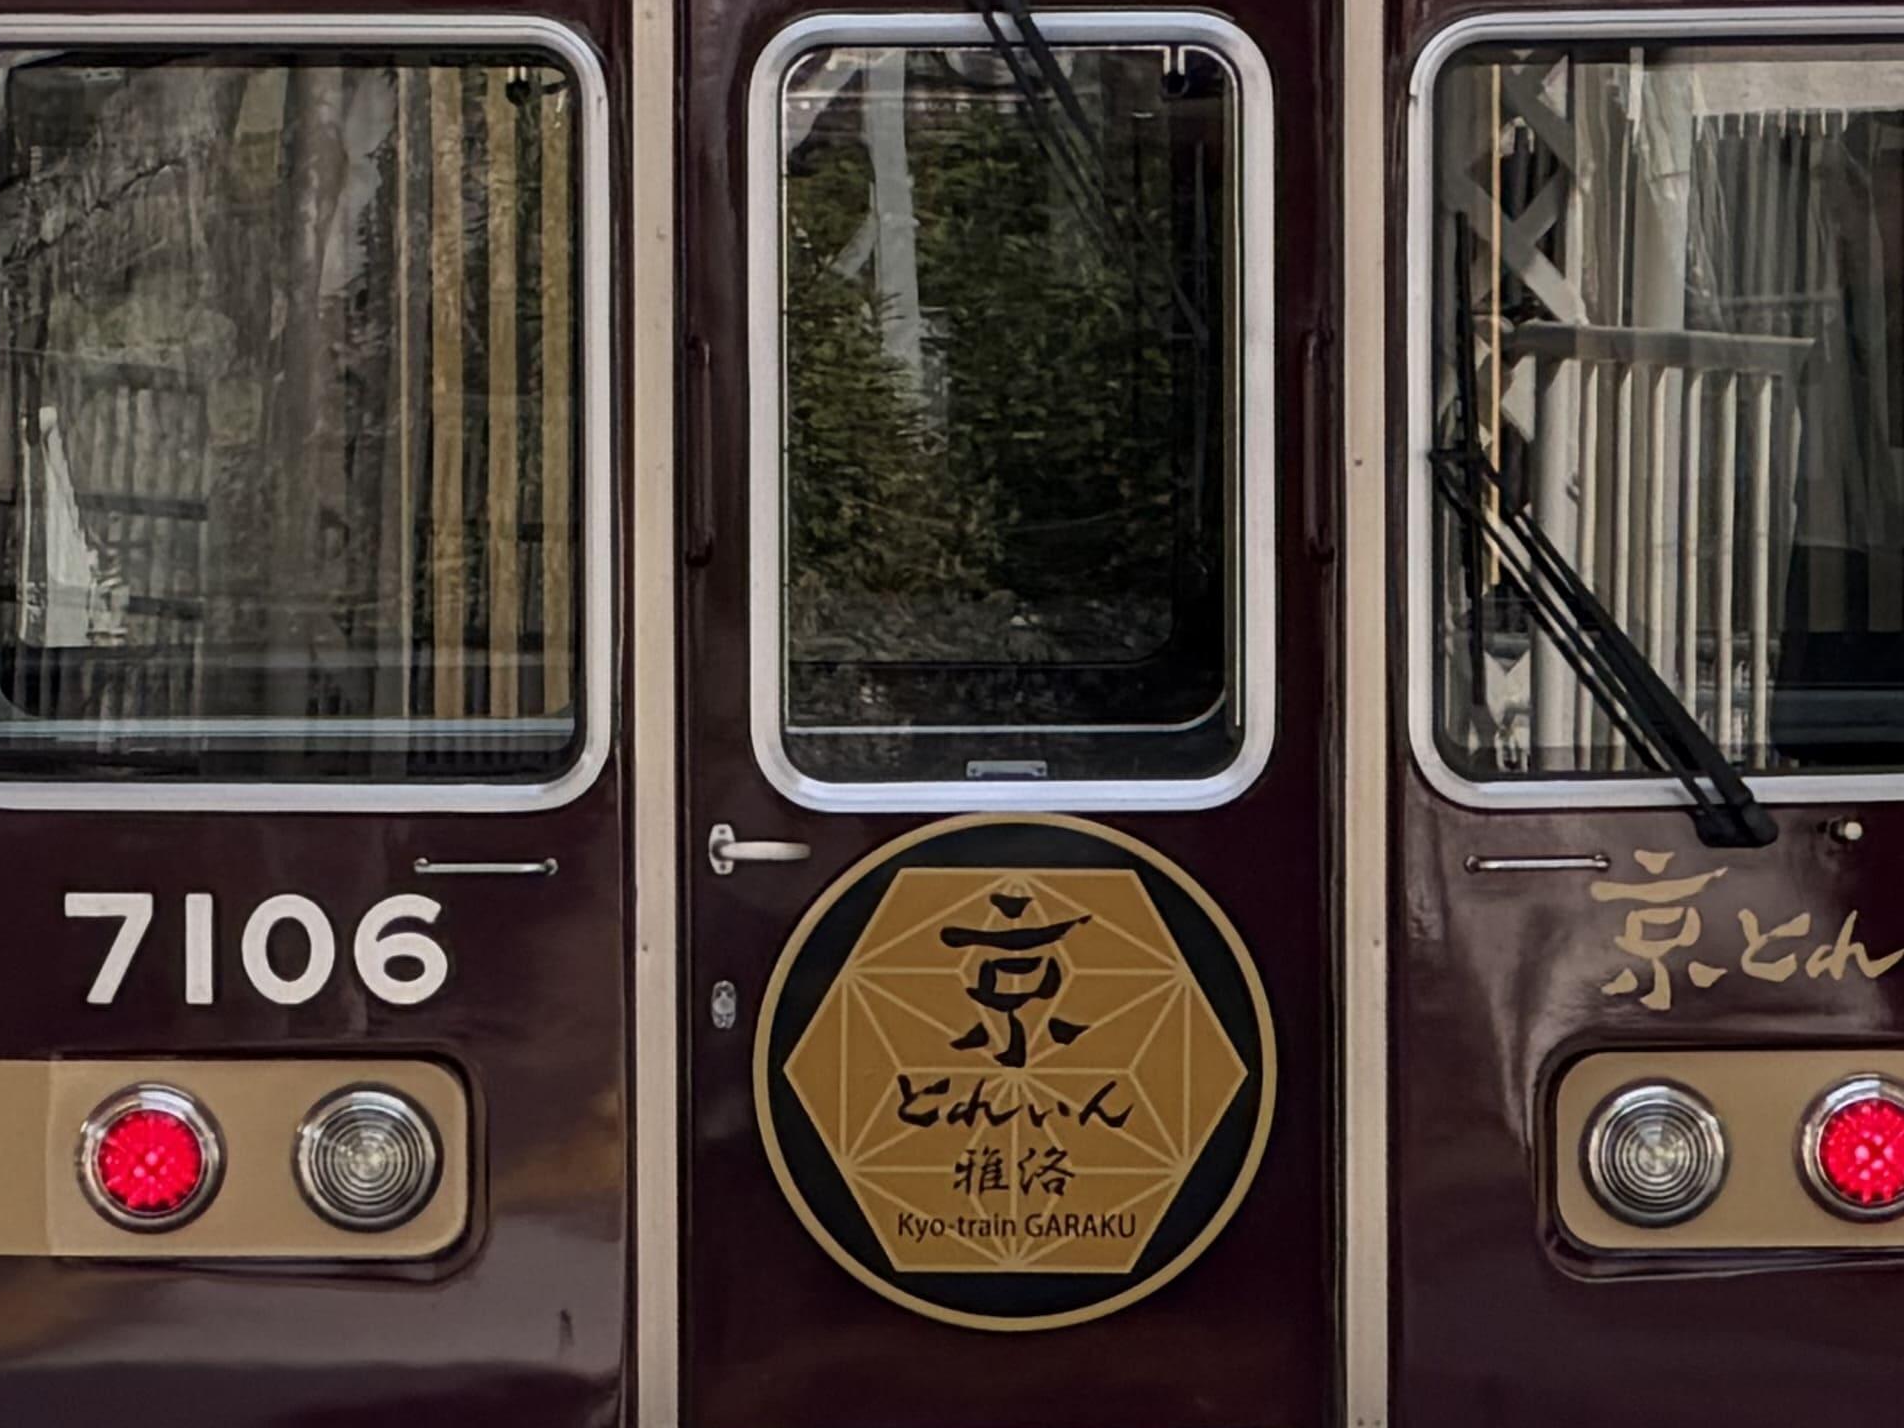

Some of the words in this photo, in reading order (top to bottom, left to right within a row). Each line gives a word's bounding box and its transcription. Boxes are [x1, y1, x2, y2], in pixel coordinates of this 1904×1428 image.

[63, 891, 449, 1006] 7106
[939, 893, 1094, 1068] 京
[896, 1073, 1135, 1131] とれいん
[953, 1146, 1077, 1198] 雅洛
[897, 1212, 1017, 1243] Kyo-train
[1024, 1213, 1137, 1239] GARAKU
